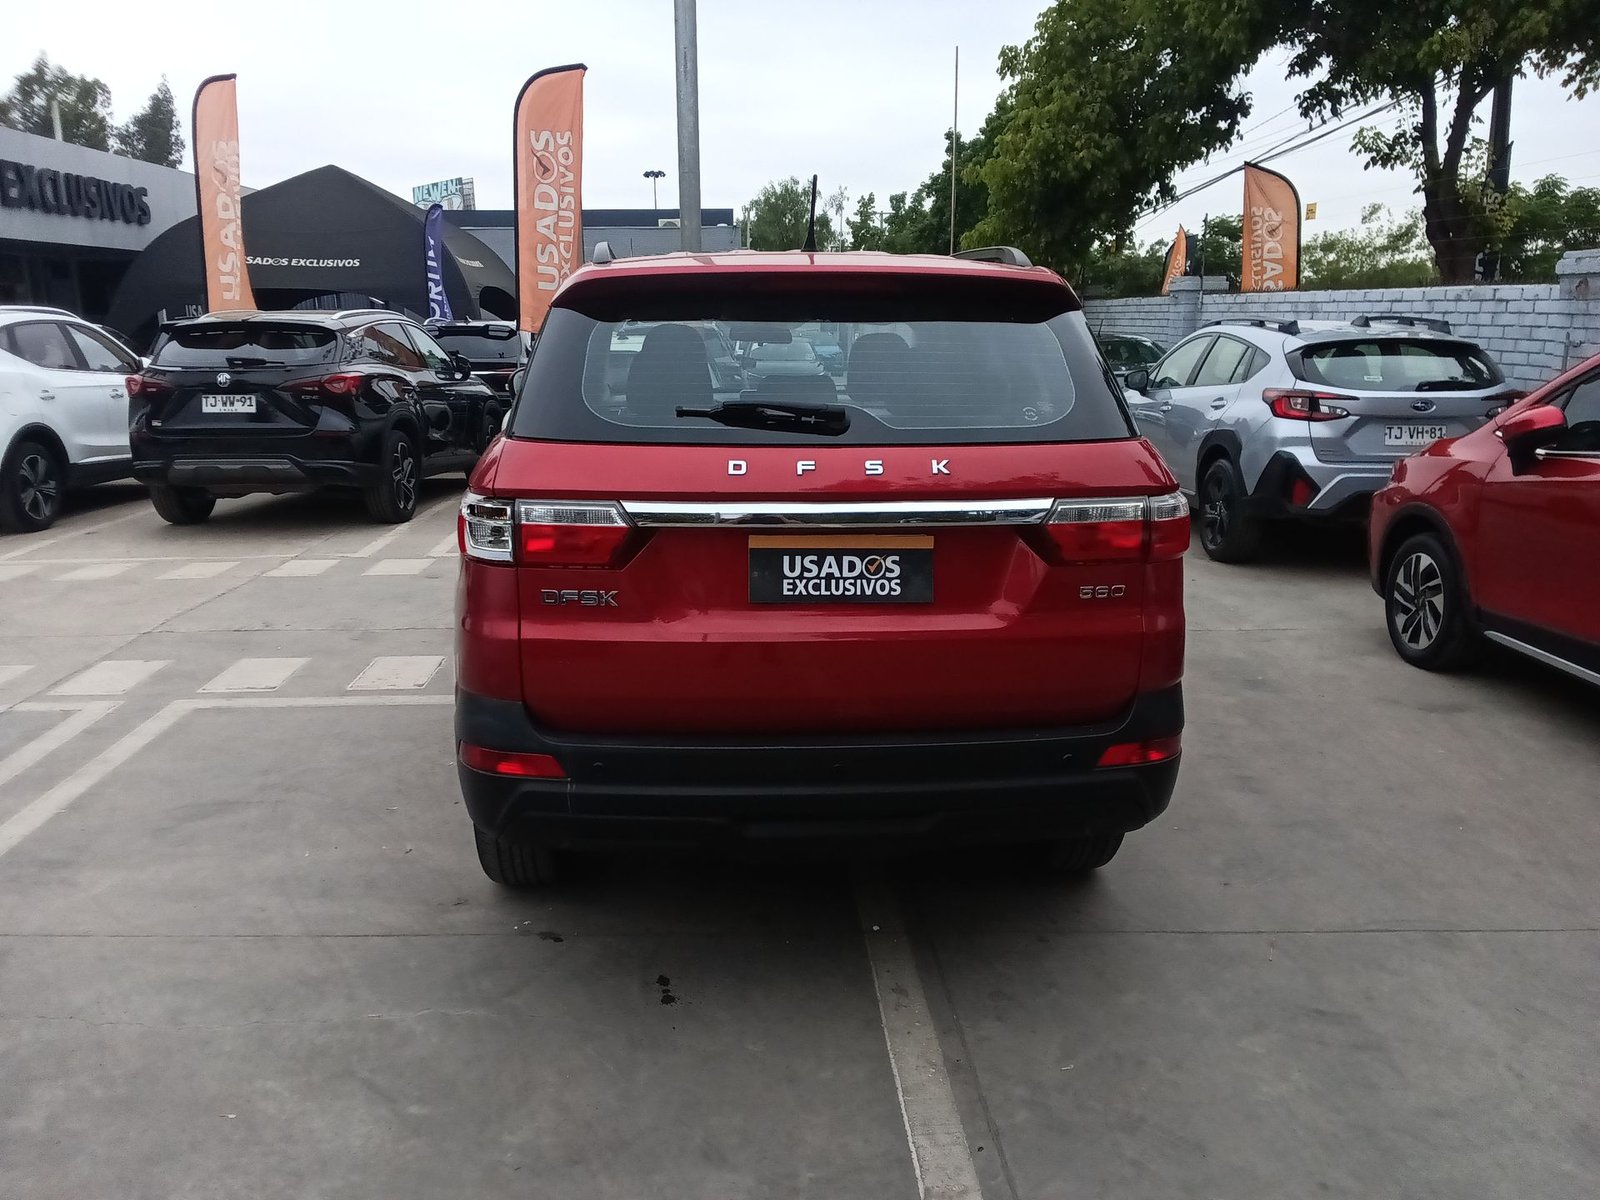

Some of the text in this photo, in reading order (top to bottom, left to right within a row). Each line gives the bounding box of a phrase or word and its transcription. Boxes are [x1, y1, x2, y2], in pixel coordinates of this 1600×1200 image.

[0, 159, 151, 225] EXCLUSIVOS
[529, 129, 560, 291] USADOS
[245, 256, 360, 267] SADOS EXCLUSIVOS
[783, 555, 900, 579] USADOS
[783, 579, 901, 596] EXCLUSIVOS
[1080, 585, 1125, 599] 560
[541, 589, 619, 606] DFSK
